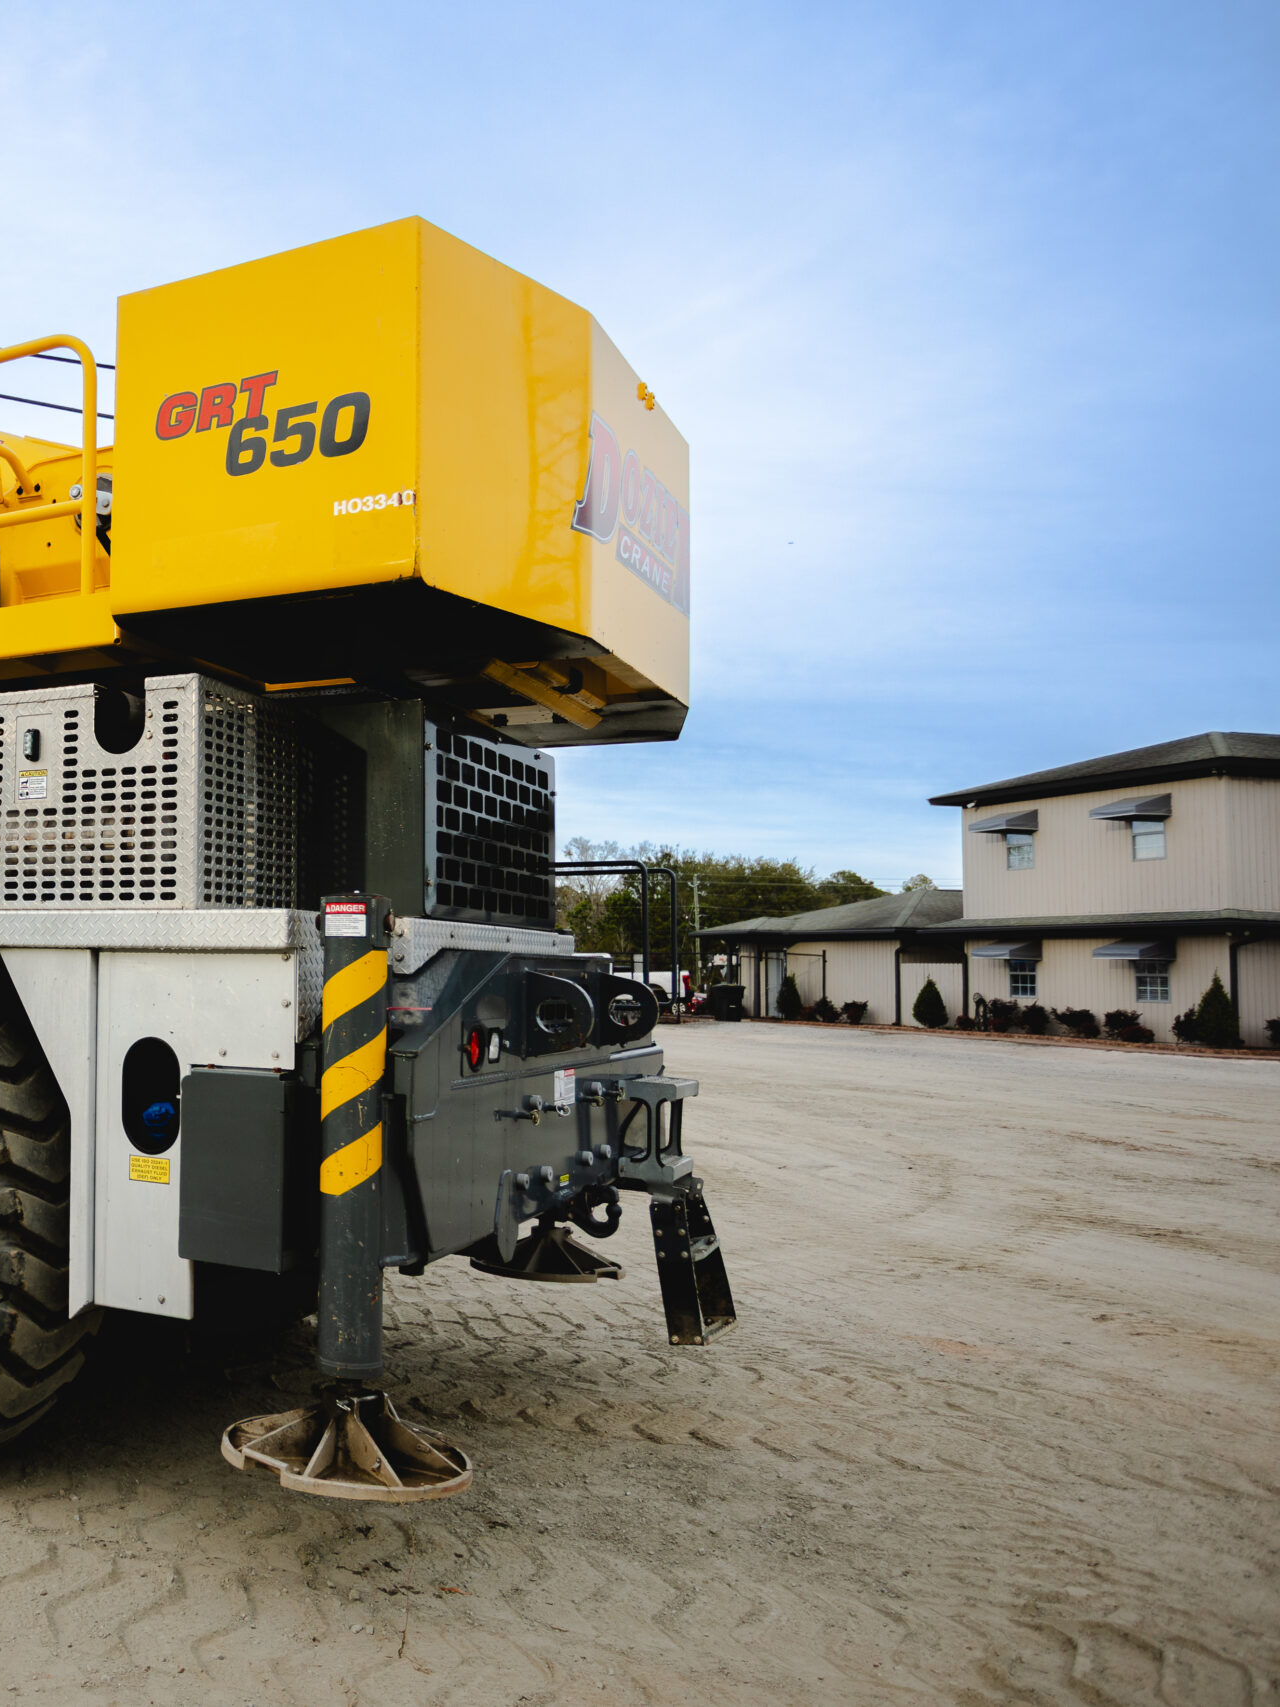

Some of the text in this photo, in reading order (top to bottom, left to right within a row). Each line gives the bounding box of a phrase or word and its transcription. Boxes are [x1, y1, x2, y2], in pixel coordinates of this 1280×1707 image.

[155, 370, 279, 440] GRT
[225, 391, 371, 477] 650
[620, 535, 671, 593] CRANE
[330, 904, 366, 912] DANGER
